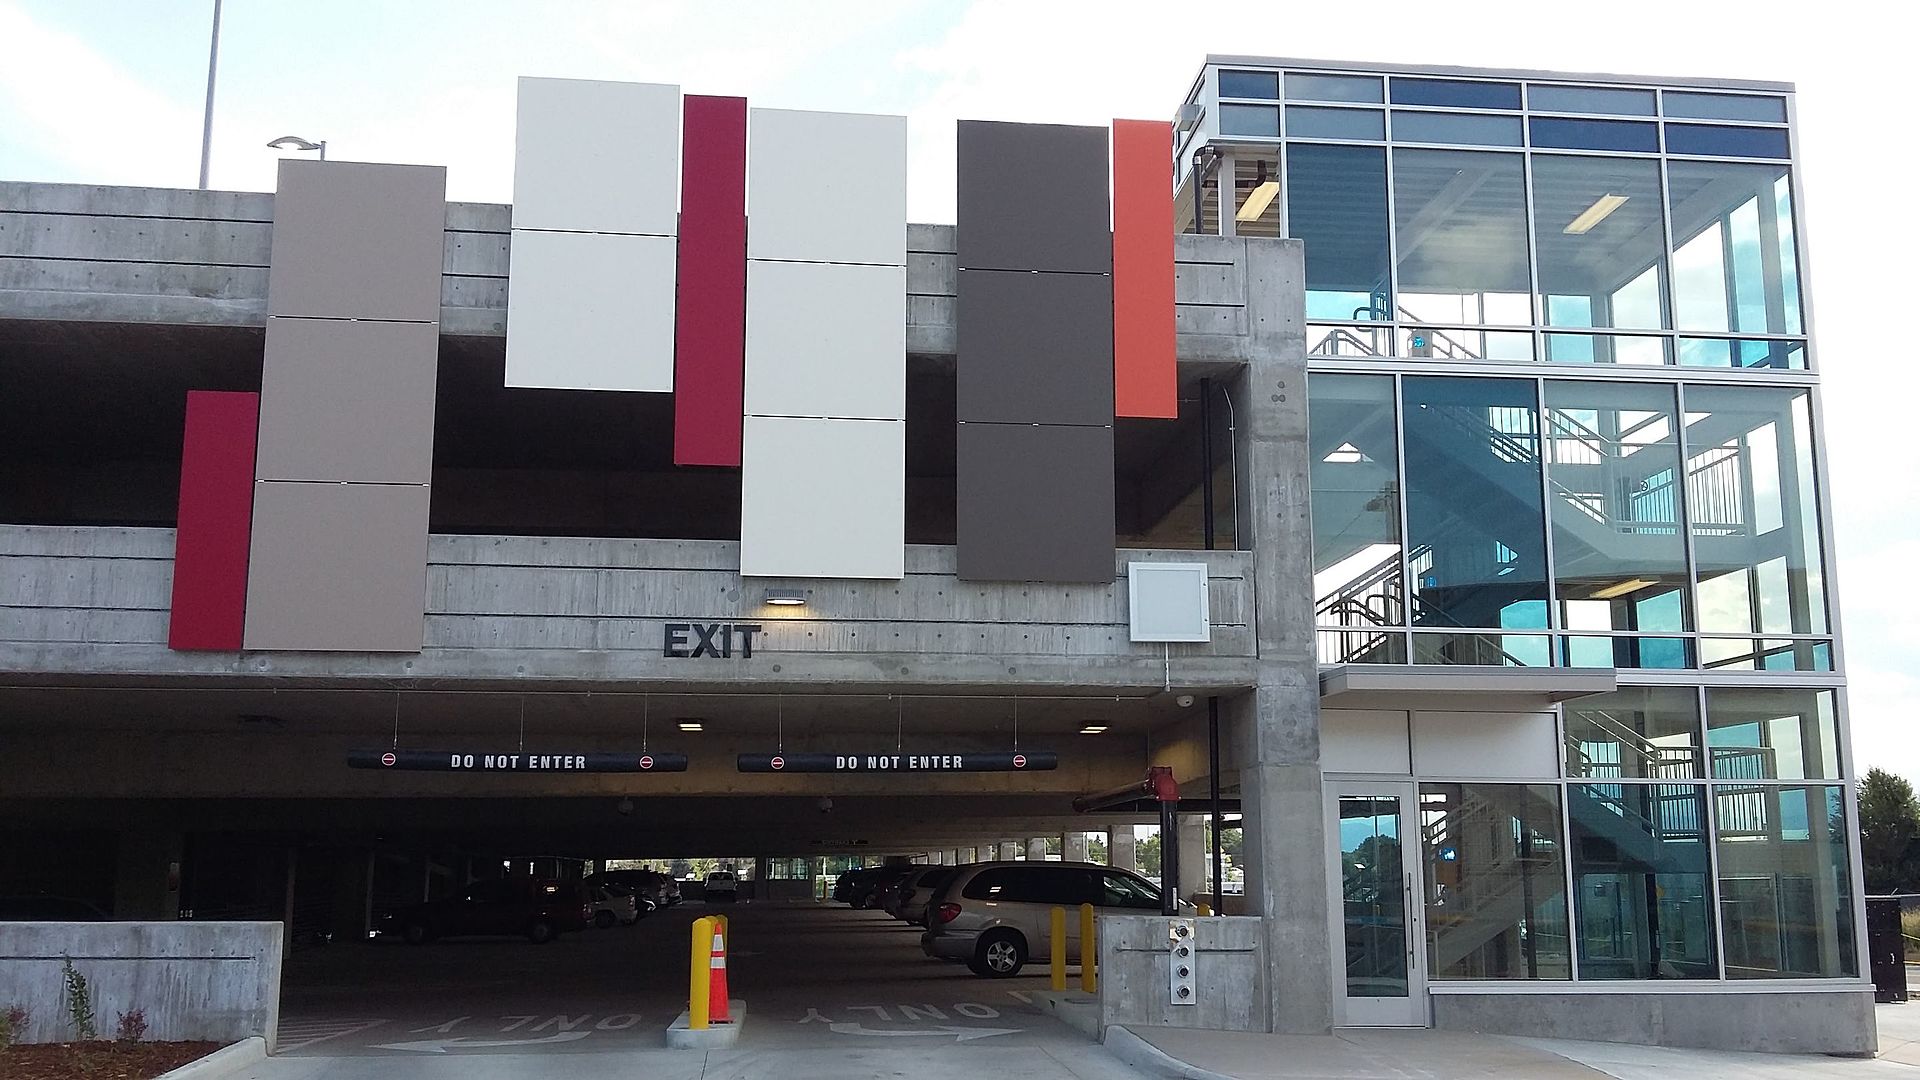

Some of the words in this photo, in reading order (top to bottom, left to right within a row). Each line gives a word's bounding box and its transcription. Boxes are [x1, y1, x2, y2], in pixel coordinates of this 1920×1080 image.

[664, 623, 762, 658] EXIT
[451, 755, 474, 768] DO
[484, 755, 520, 769] NOT
[529, 755, 586, 769] ENTER
[836, 756, 858, 769] DO
[867, 756, 900, 769] NOT
[909, 756, 963, 769] ENTER
[408, 1013, 643, 1034] ONLY
[795, 1002, 1001, 1024] ONLY
